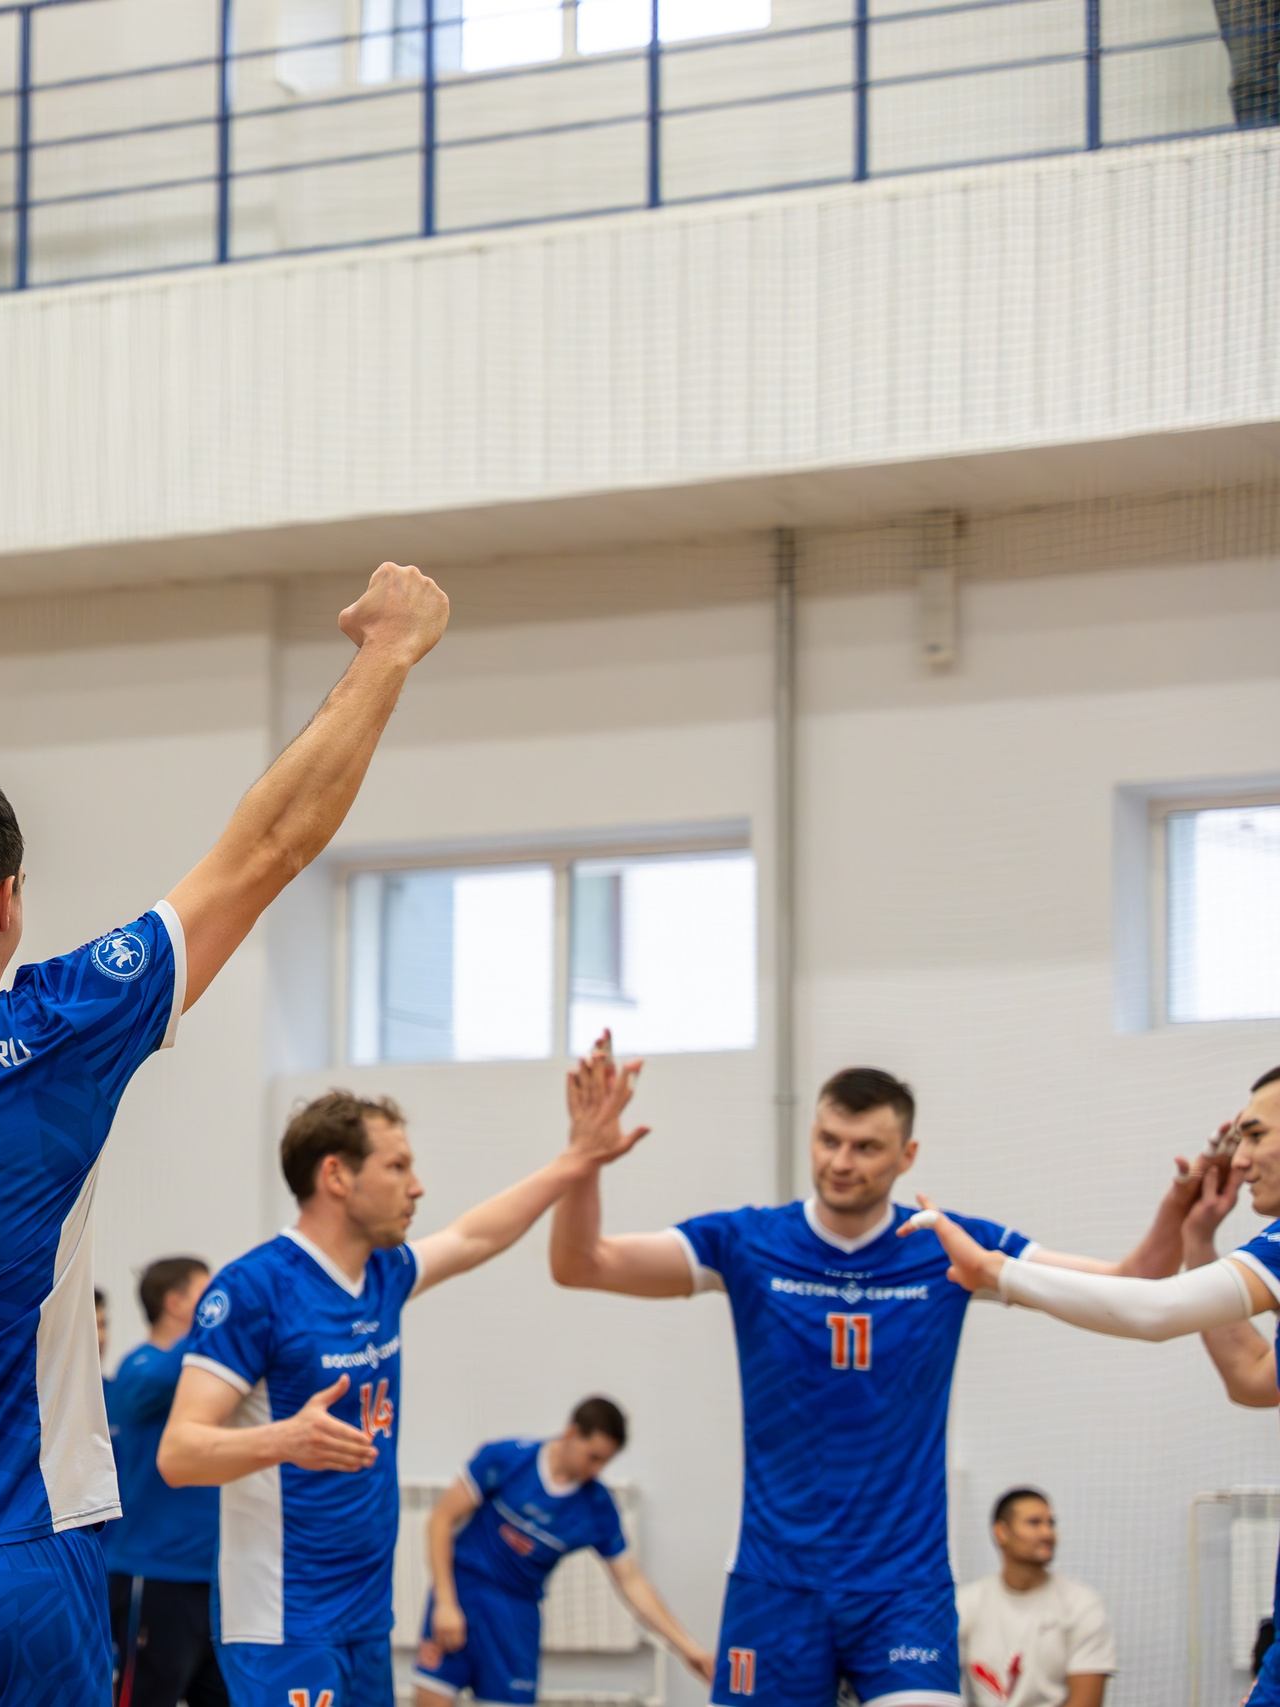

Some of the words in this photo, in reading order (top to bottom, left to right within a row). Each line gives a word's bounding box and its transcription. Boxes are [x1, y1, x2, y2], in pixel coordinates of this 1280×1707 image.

[827, 1312, 872, 1371] 11
[360, 1378, 394, 1438] 14
[728, 1646, 756, 1696] 11
